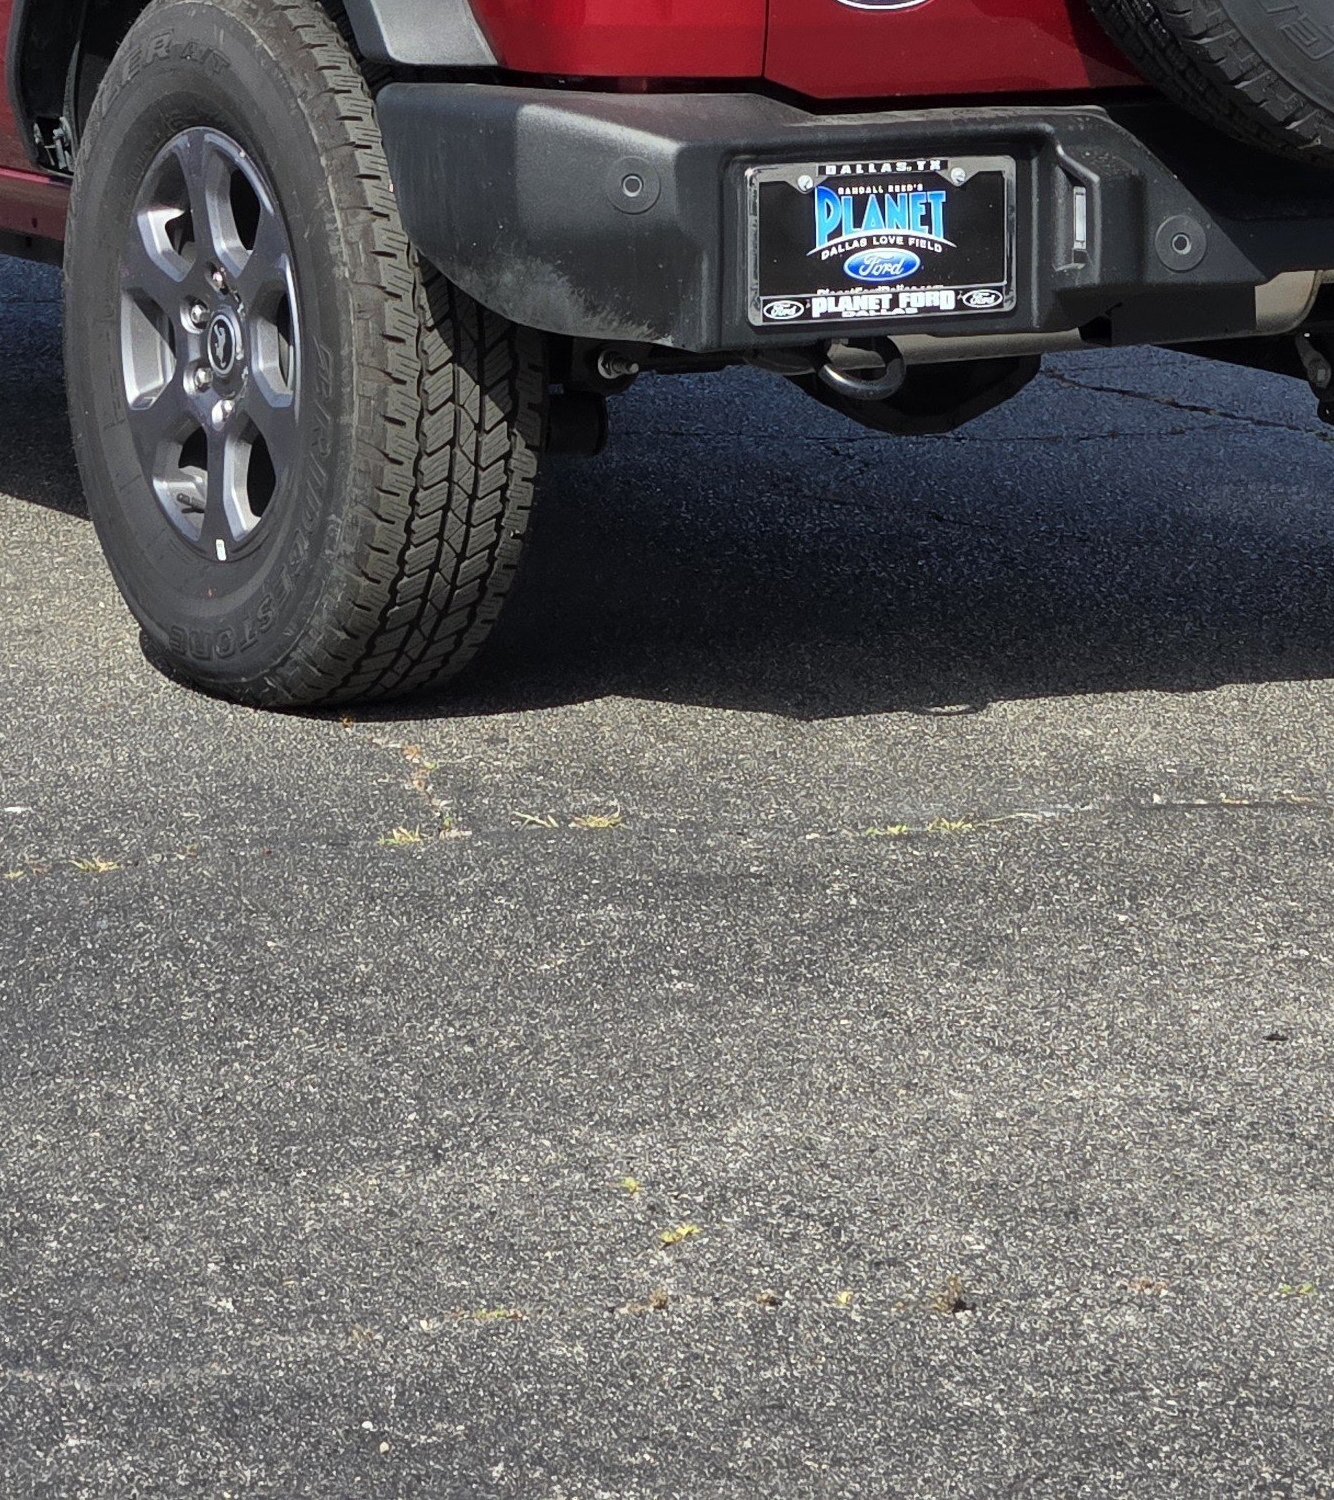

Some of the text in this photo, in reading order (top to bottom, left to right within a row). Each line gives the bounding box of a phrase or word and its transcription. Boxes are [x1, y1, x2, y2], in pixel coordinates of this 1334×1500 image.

[917, 160, 941, 171] TX
[814, 185, 948, 249] PLANET
[821, 235, 943, 260] DALLAS LOVE FIELD
[859, 252, 906, 277] Ford
[770, 290, 998, 319] Ford PLANET FORD Ford
